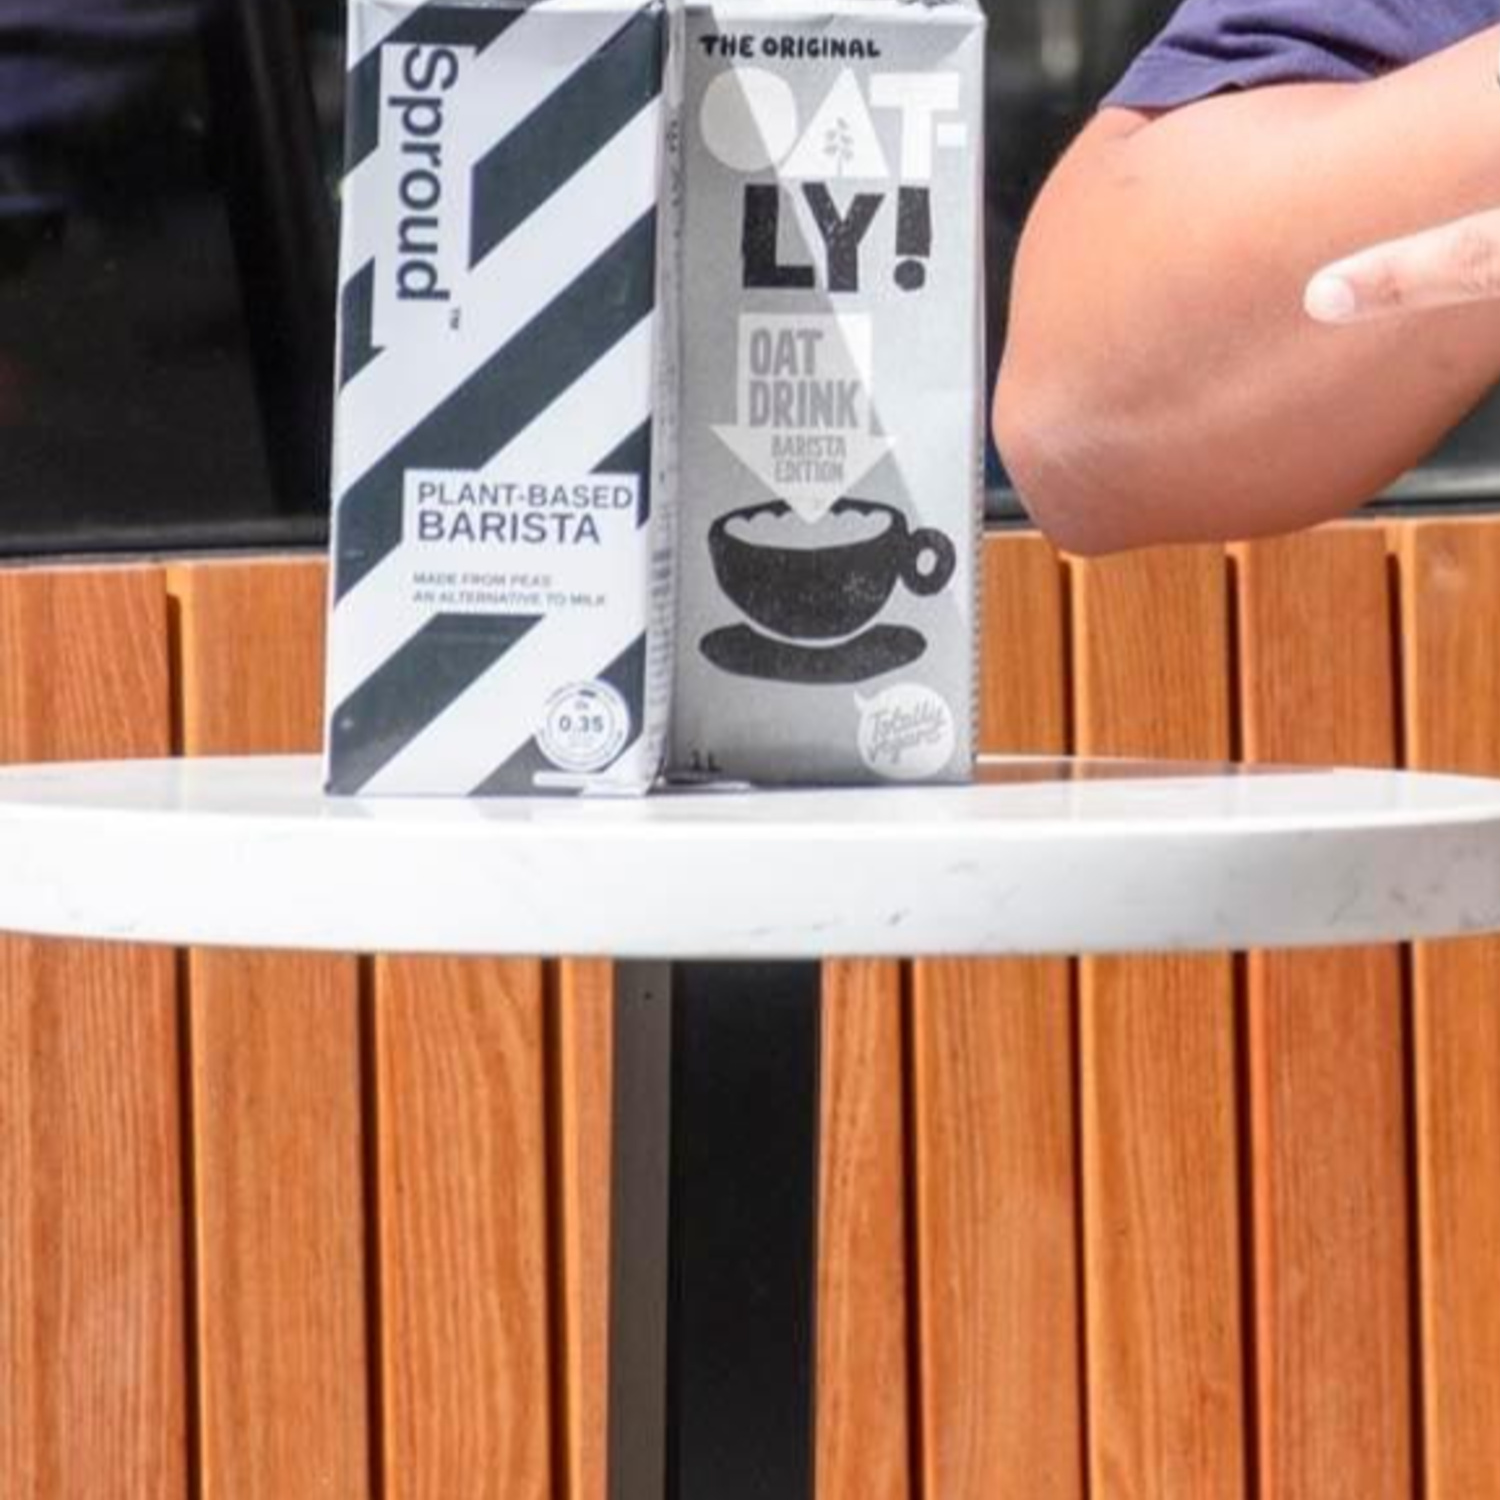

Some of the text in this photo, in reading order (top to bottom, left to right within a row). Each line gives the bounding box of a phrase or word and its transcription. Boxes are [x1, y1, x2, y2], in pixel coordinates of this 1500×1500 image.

[699, 34, 881, 59] THE ORIGINAL
[388, 44, 459, 302] Sproud
[741, 181, 932, 293] LY!
[749, 327, 825, 377] OAT
[748, 379, 860, 428] DRINK
[770, 433, 847, 458] BARISTA
[774, 460, 845, 484] EDITION
[417, 481, 634, 510] PLANT-BASED
[417, 509, 602, 545] BARISTA
[413, 571, 552, 588] MADE FROM PEAS
[413, 589, 606, 607] AN ALTERNATIVE TO MILK
